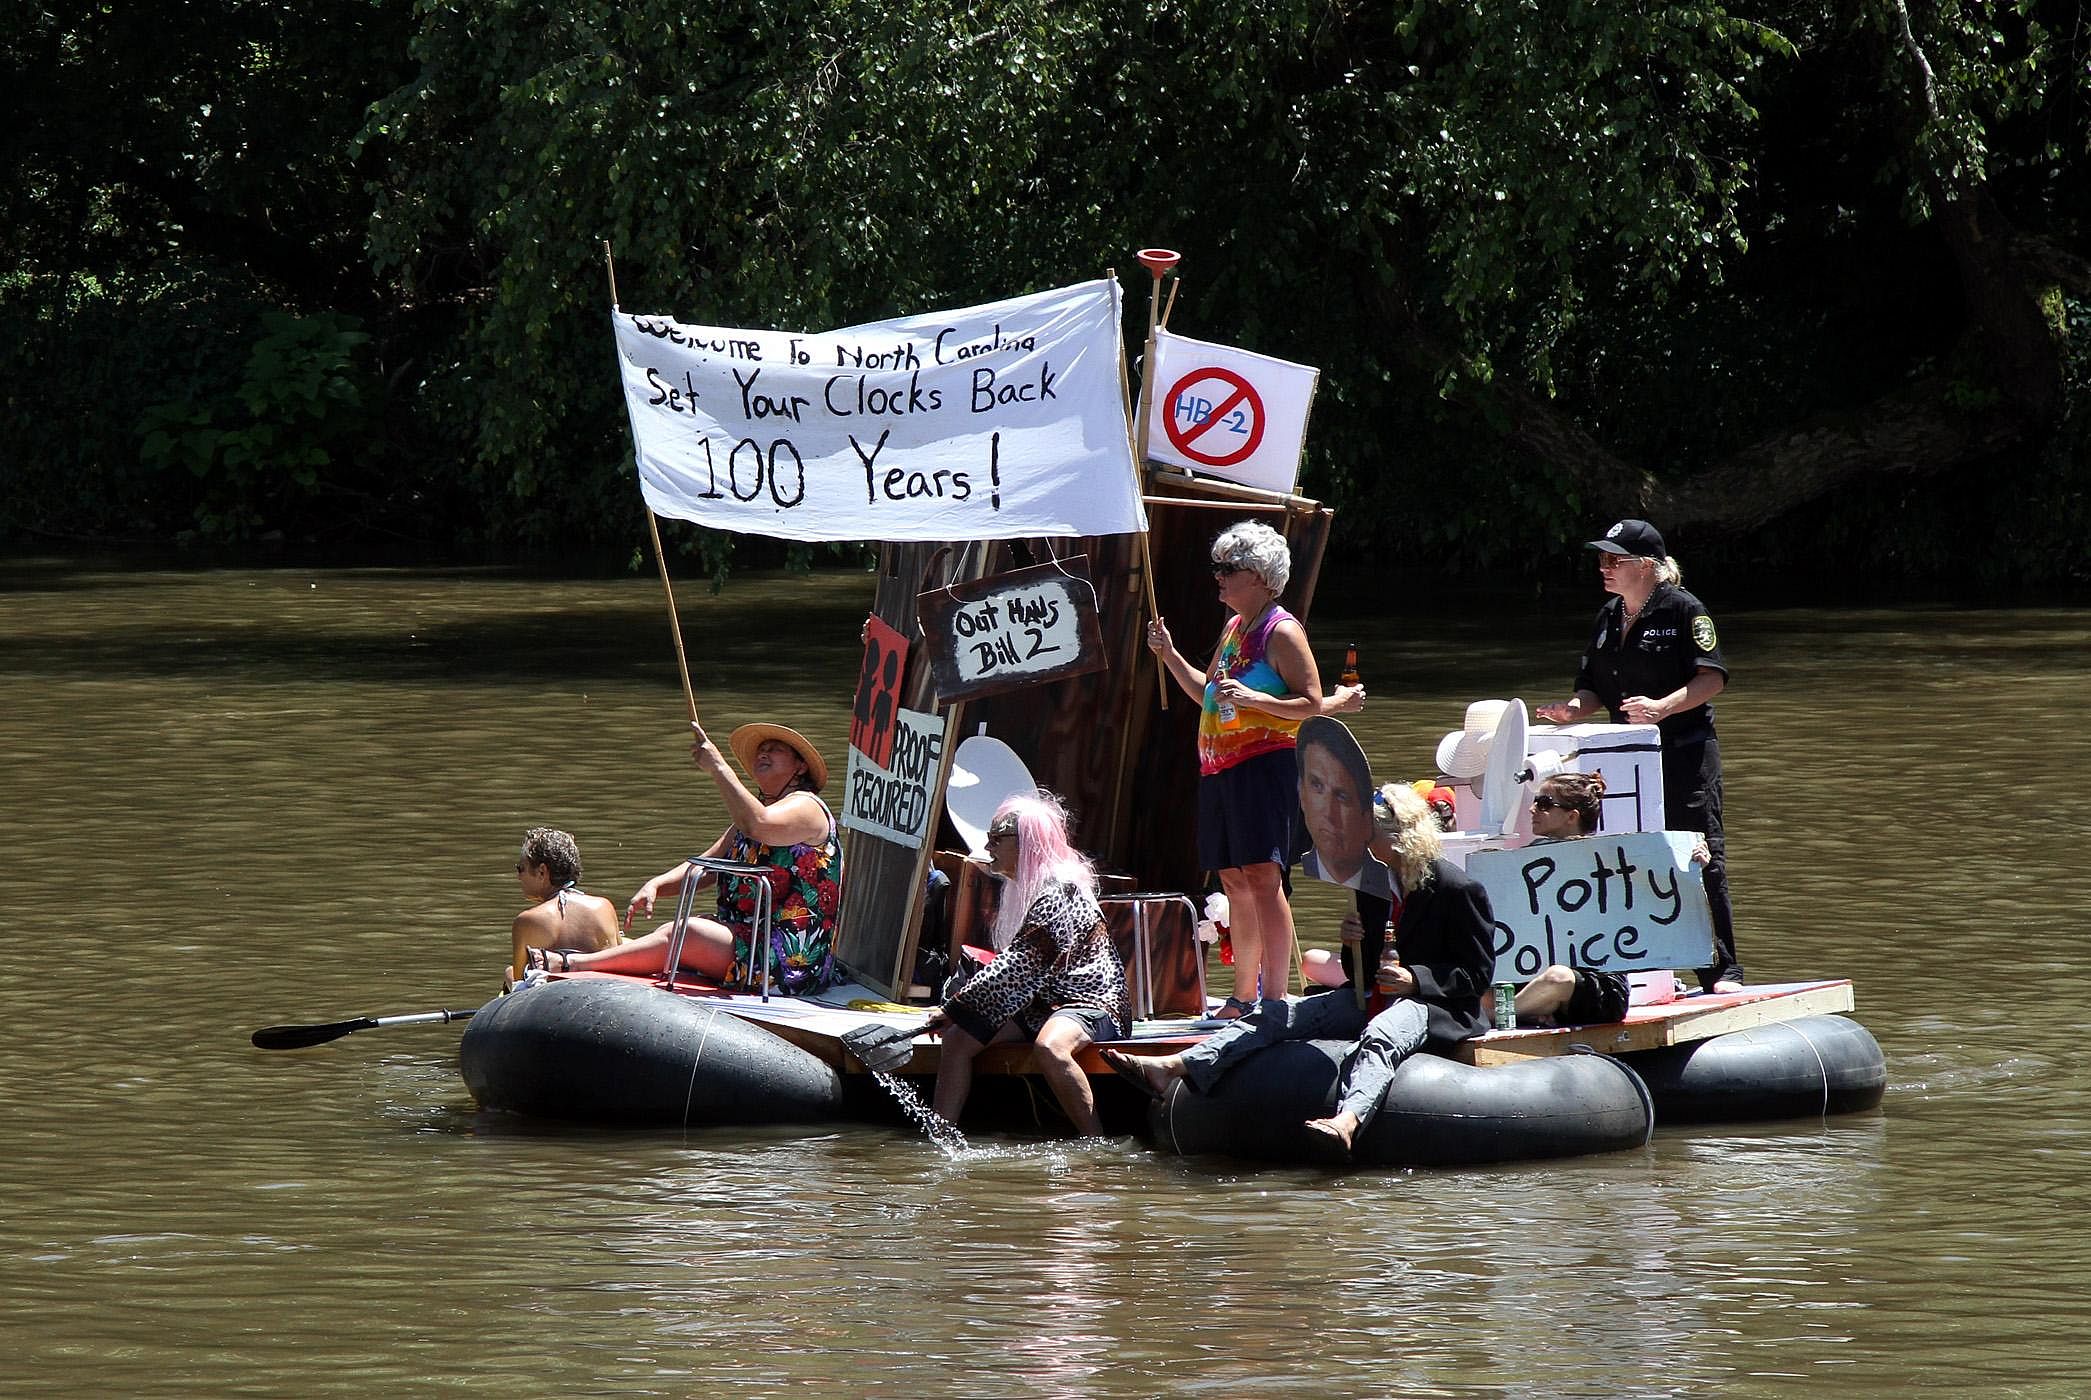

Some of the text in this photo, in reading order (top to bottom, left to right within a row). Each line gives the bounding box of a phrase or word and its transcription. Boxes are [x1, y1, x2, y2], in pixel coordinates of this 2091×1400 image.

[789, 339, 810, 365] To
[836, 342, 920, 371] North
[648, 361, 1057, 423] Set Your Clocks Back
[698, 437, 805, 509] 100
[956, 600, 999, 638] Out
[1642, 628, 1678, 638] POLICE
[969, 628, 1061, 675] Bill 2
[890, 719, 943, 788] PROOF
[851, 767, 927, 835] REQUIRED
[1521, 845, 1681, 925] Potty
[1494, 914, 1648, 976] Police
